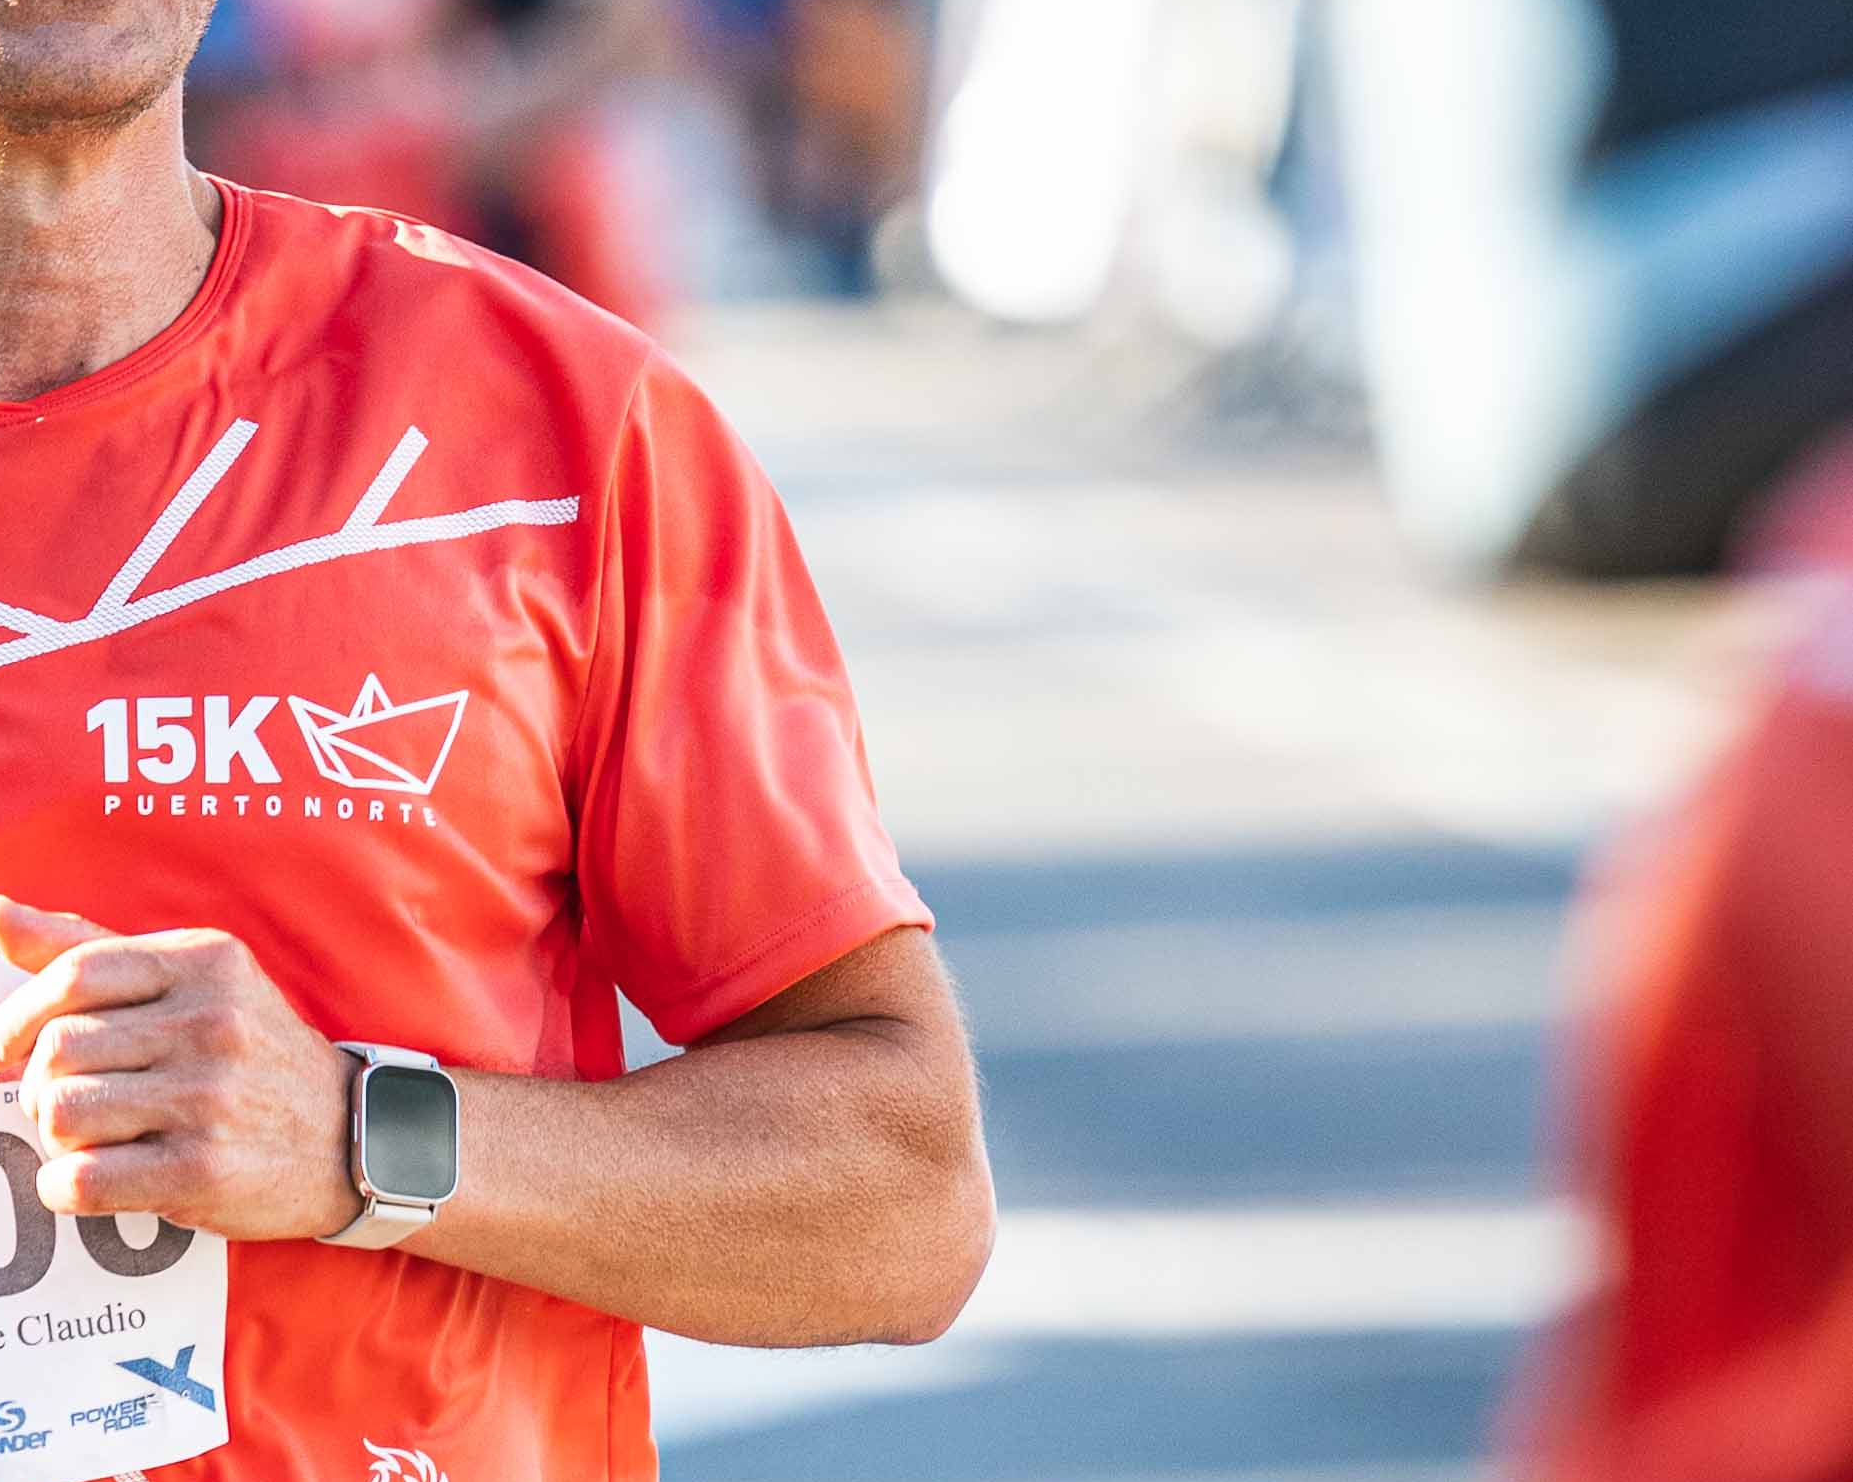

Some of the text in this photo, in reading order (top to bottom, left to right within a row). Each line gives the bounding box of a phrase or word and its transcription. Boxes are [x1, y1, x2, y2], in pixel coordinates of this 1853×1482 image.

[86, 695, 283, 785] 15K
[104, 795, 437, 826] PUERTO NORTE
[17, 1302, 147, 1346] Claudio
